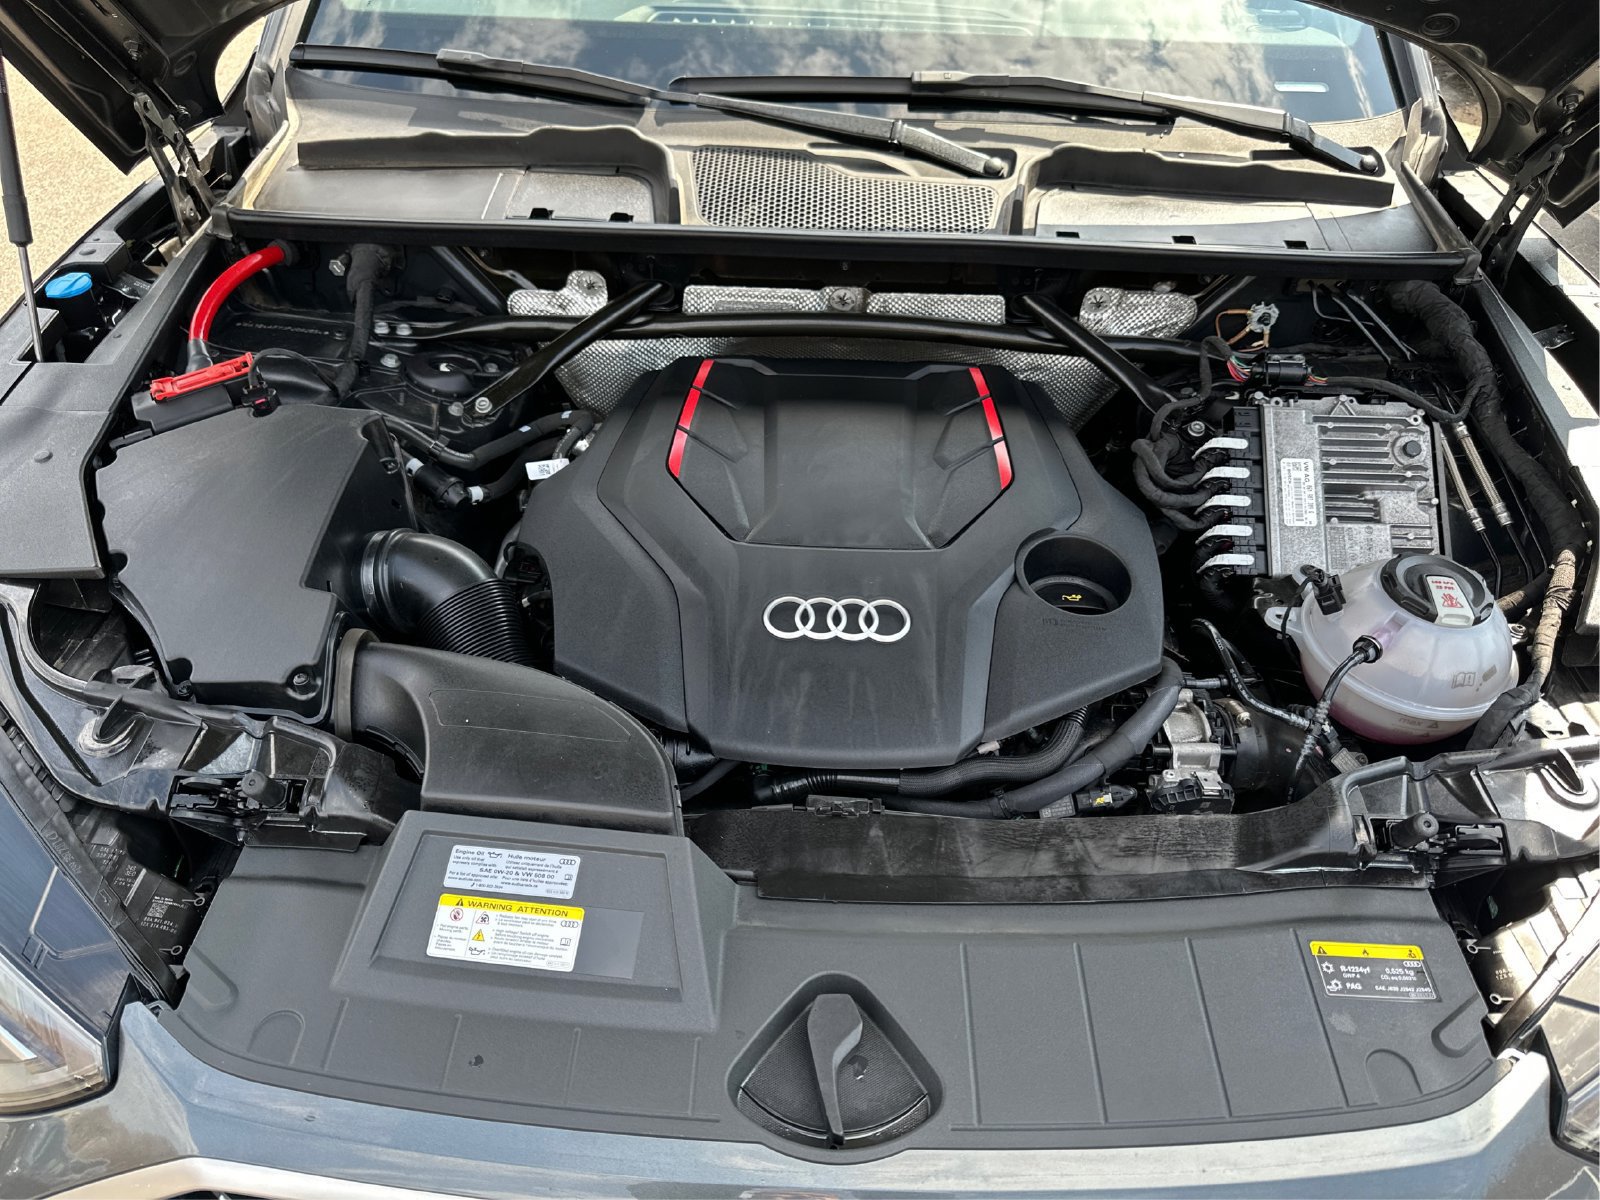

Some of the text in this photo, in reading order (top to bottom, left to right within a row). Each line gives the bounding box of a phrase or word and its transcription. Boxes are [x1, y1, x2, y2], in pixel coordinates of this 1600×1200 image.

[1304, 462, 1309, 472] VW
[467, 901, 568, 917] WARNING ATTENTION
[1345, 982, 1363, 990] PAG
